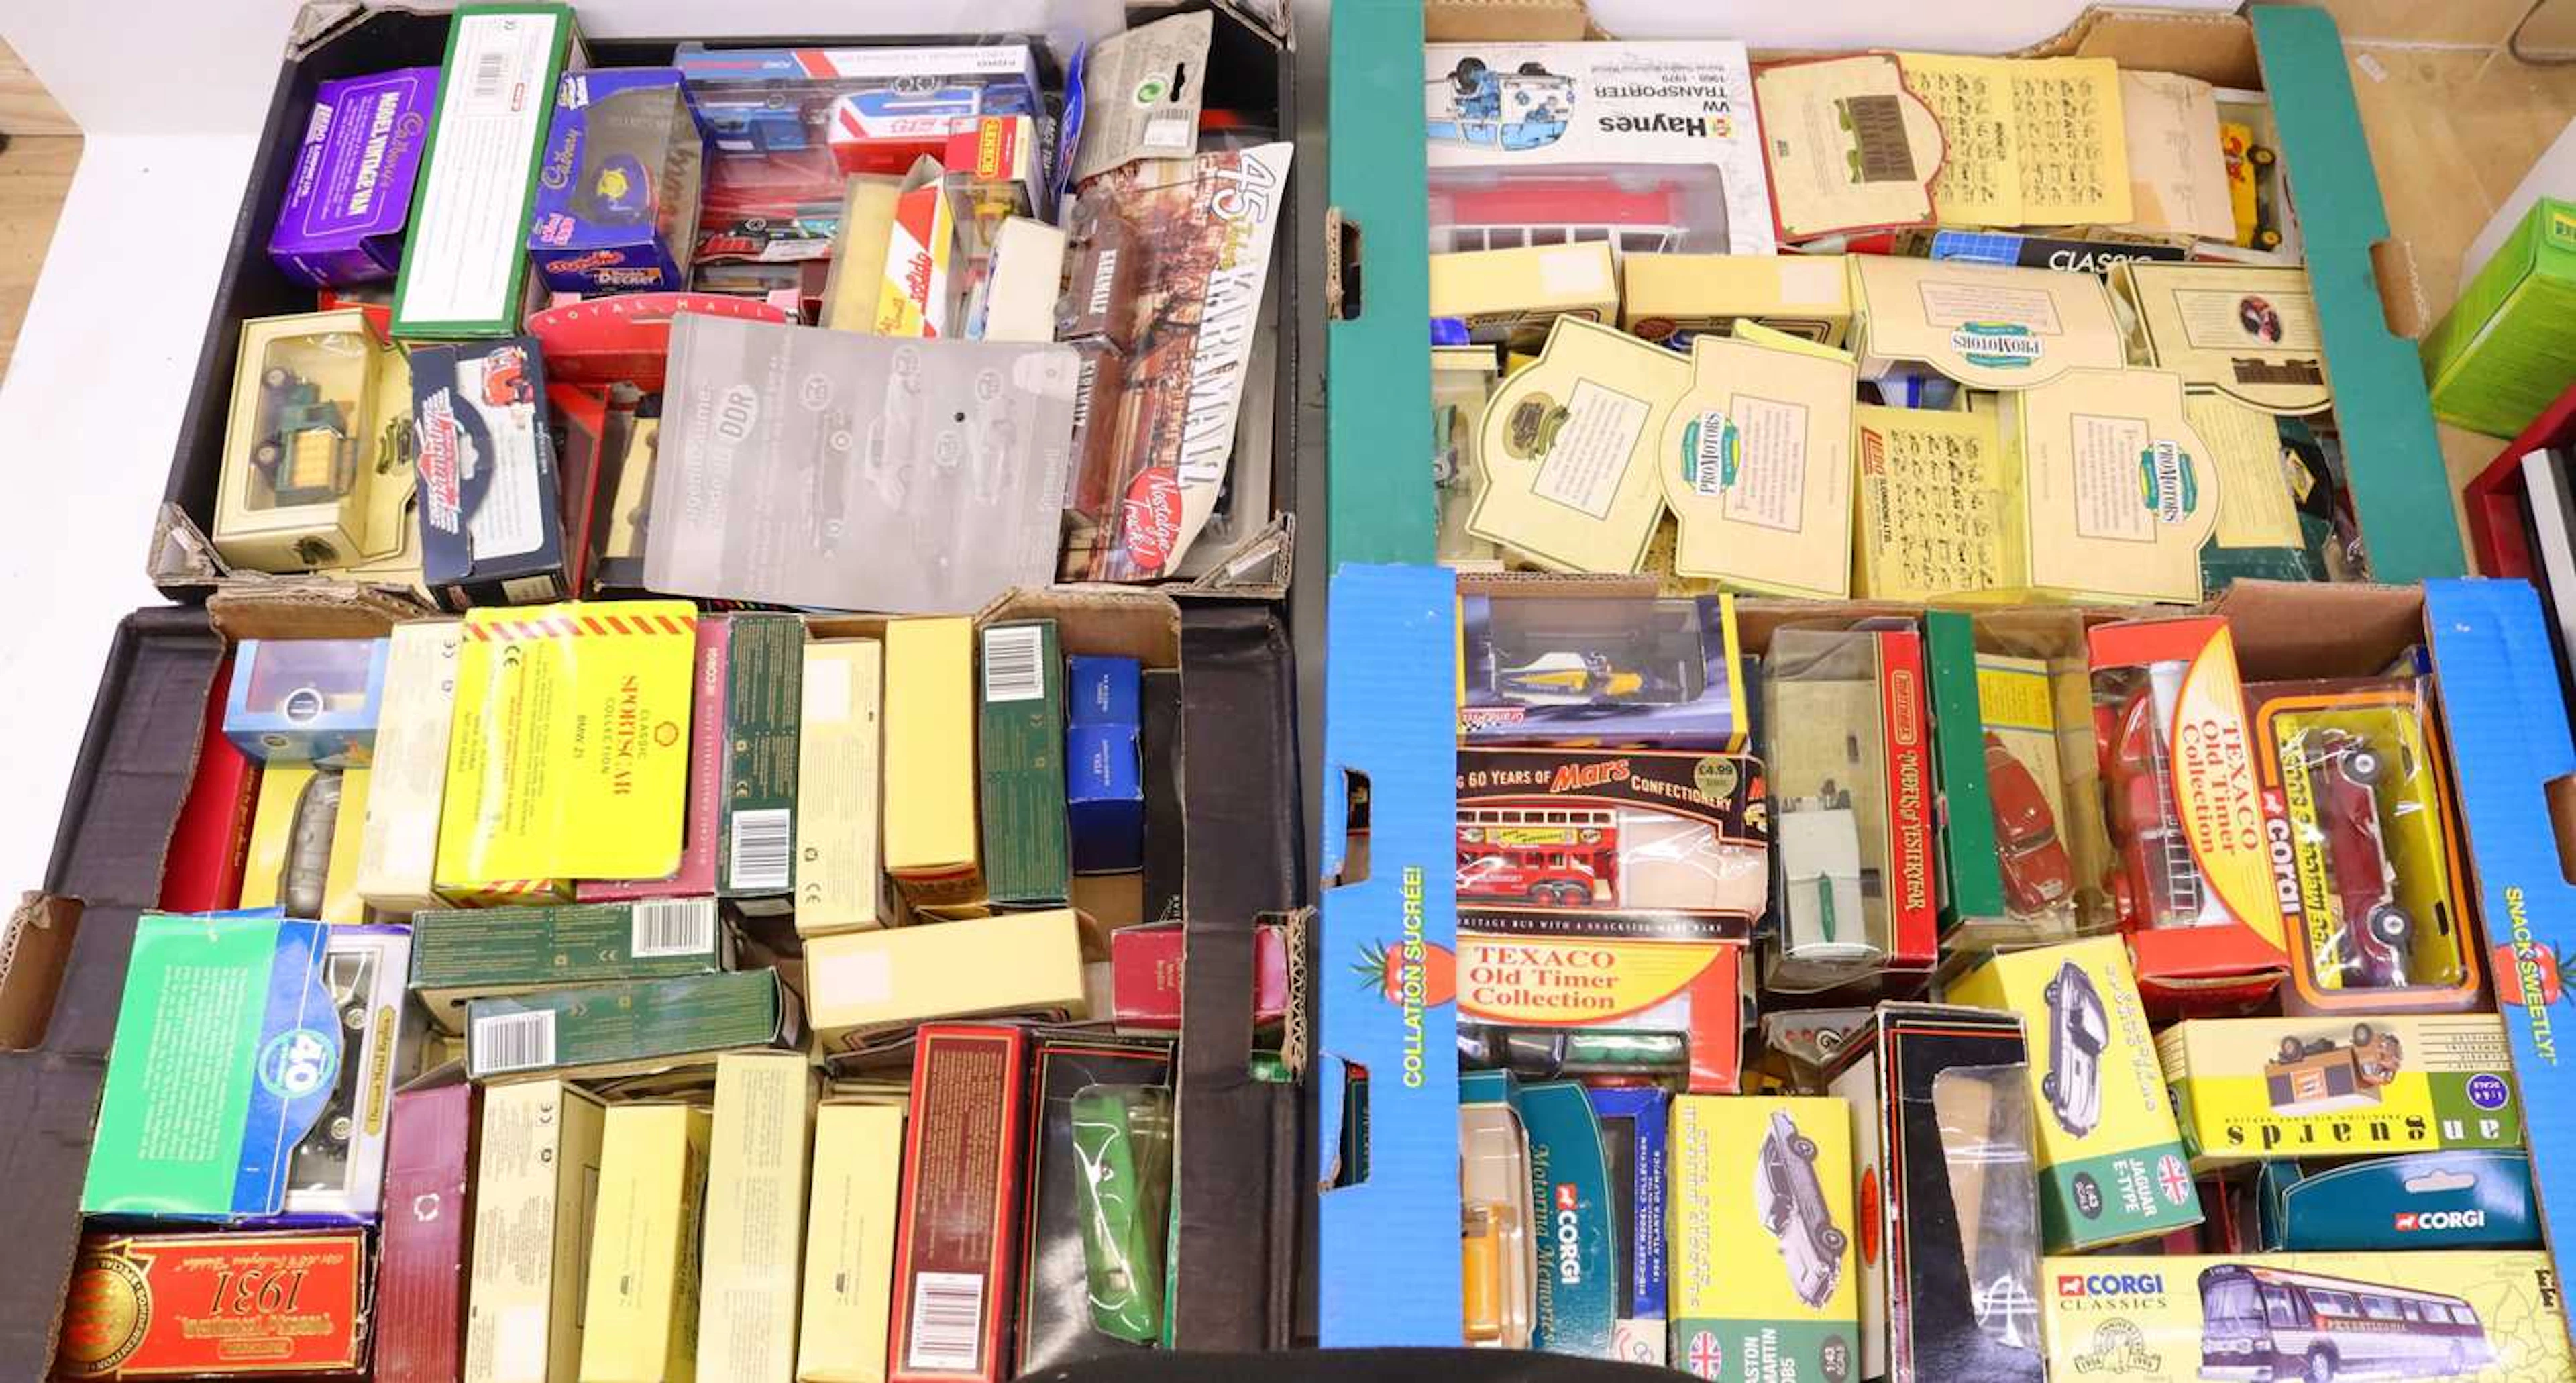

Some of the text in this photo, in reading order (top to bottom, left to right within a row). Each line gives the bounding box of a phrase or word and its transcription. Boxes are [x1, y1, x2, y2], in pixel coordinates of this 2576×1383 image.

[1593, 85, 1729, 99] TRANSPORTER
[1702, 100, 1731, 113] VW
[1599, 114, 1707, 138] Haynes
[541, 129, 583, 189] Cadbury
[1210, 152, 1277, 224] 45
[905, 251, 933, 303] solido
[676, 299, 764, 318] MAIL
[718, 391, 753, 439] DDR
[575, 714, 587, 743] BMW
[600, 697, 614, 774] COLLECTION
[613, 674, 638, 797] SPORTSCAR
[637, 709, 649, 760] CLASSIC
[1468, 771, 1486, 787] 60
[1491, 770, 1532, 786] YEARS
[1534, 769, 1550, 784] OF
[1550, 759, 1633, 794] Mars
[2183, 723, 2215, 854] Collection
[2201, 719, 2236, 854] Old Timer
[2220, 719, 2260, 852] TEXACO
[1456, 918, 1505, 928] RITAGE
[1401, 865, 1424, 1088] COLLATION SUCRÉE!
[1468, 967, 1621, 990] Old Timer
[1474, 947, 1617, 968] TEXACO
[2506, 886, 2556, 1060] SNACK SWEETLY!
[1472, 987, 1617, 1011] Collection
[2225, 1115, 2500, 1150] anguards
[2112, 1158, 2138, 1214] E-TYPE
[2127, 1158, 2158, 1219] JAGUAR
[2417, 1209, 2484, 1231] CORGI
[1530, 1145, 1556, 1344] Motoring Memories
[1557, 1211, 1580, 1284] CORGI
[210, 1270, 307, 1314] 1931
[2059, 1297, 2168, 1311] CLASSICS
[2086, 1274, 2165, 1295] CORGI
